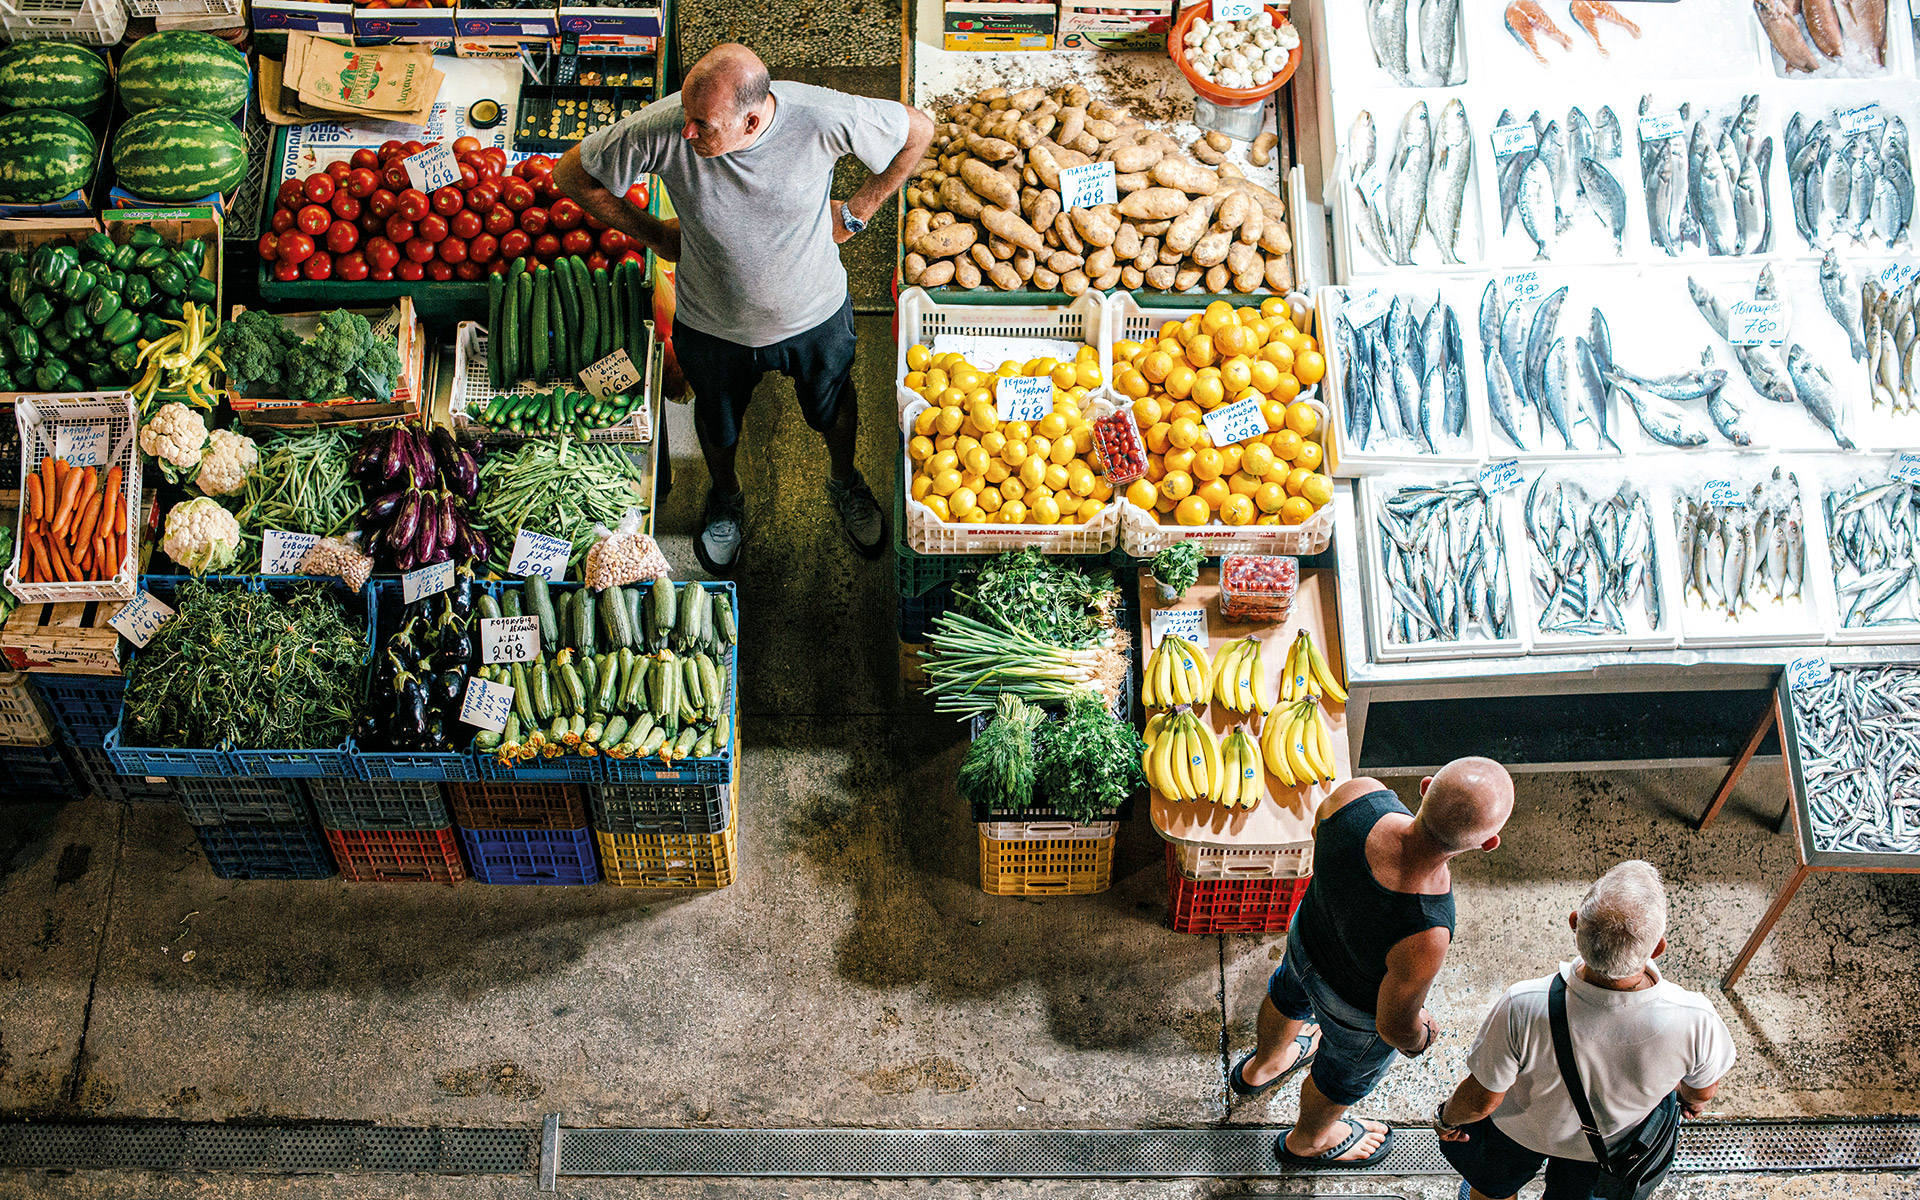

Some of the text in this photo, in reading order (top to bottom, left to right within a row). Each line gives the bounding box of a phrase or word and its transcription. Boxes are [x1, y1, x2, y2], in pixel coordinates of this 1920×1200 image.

[358, 53, 380, 79] ΦΡΟΥΤΑ
[396, 63, 416, 104] Λαχανικά
[310, 122, 338, 132] ΟΠΩ
[308, 133, 340, 142] ΛΕΙΟ
[1744, 318, 1777, 334] 7.80
[1008, 404, 1044, 421] 1.98
[1226, 424, 1260, 442] 0.98
[66, 452, 96, 466] 0.98
[1712, 488, 1740, 500] 6.80
[270, 532, 314, 542] ΤΣΑΟΥΛΙ
[516, 560, 553, 581] 2.98
[492, 642, 526, 661] 2.98
[1798, 670, 1822, 684] 6.80
